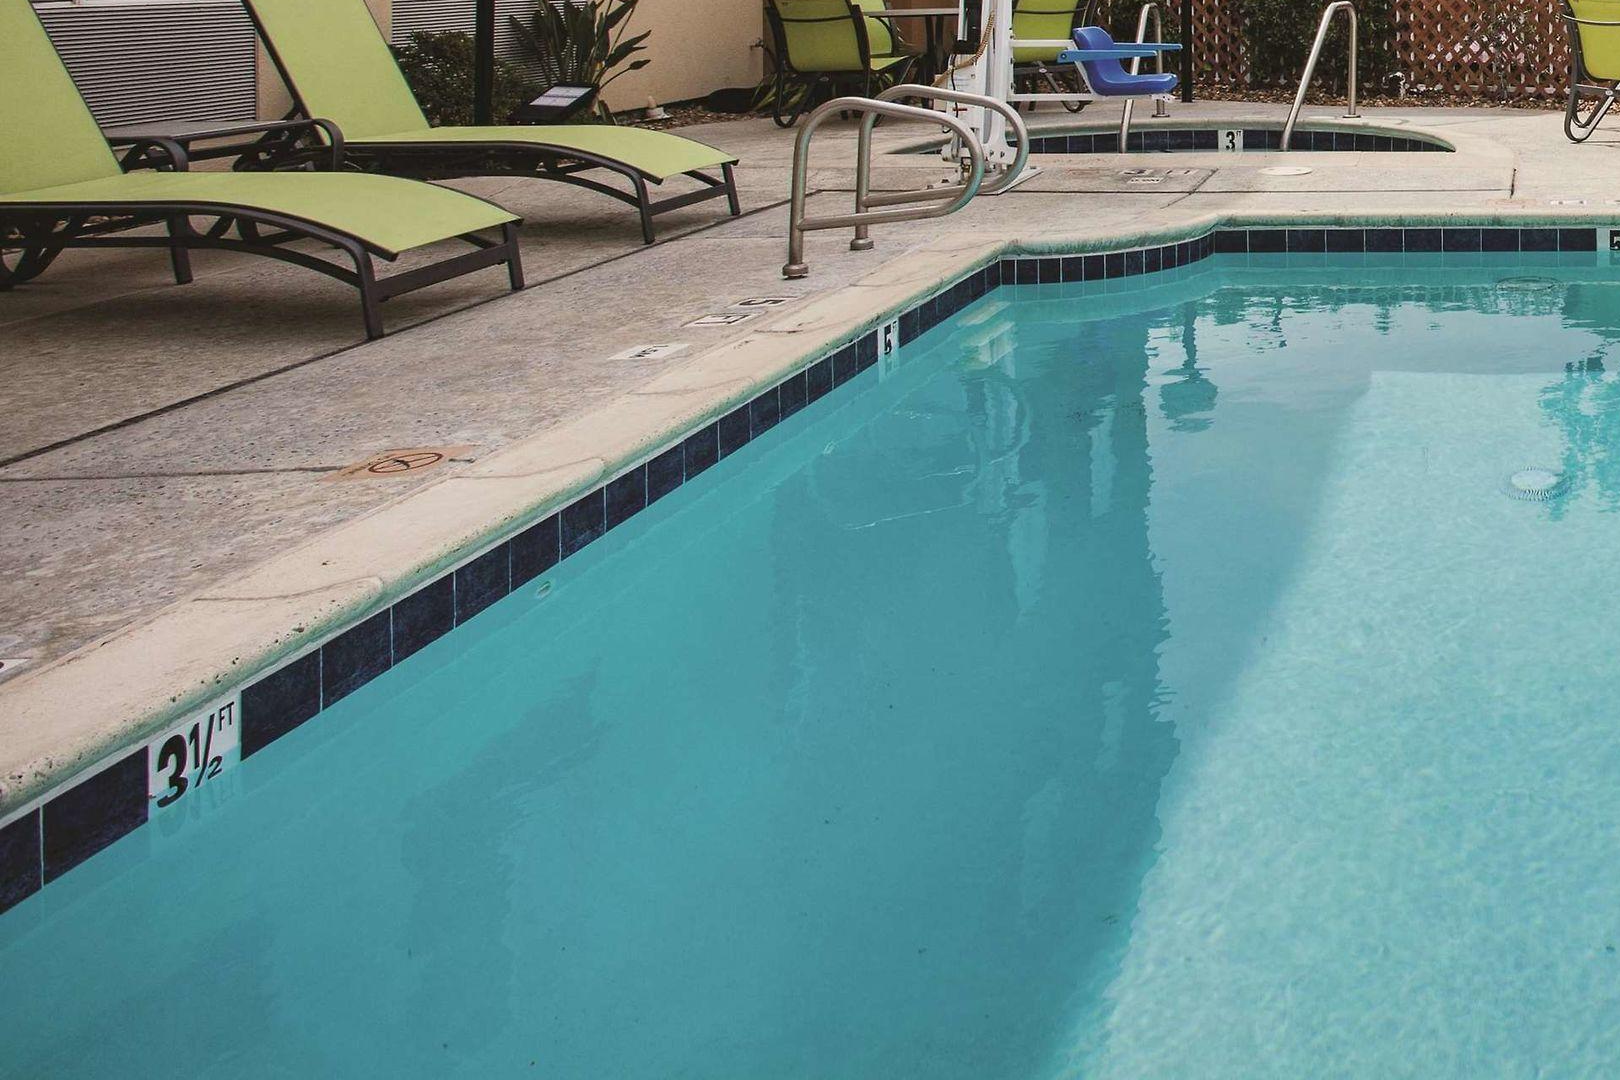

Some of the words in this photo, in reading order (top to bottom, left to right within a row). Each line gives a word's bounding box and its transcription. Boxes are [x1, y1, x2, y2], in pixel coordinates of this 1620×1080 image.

[1226, 131, 1235, 152] 3
[738, 299, 786, 307] 5
[694, 314, 750, 325] FT
[884, 323, 892, 355] 5
[218, 701, 235, 731] FT
